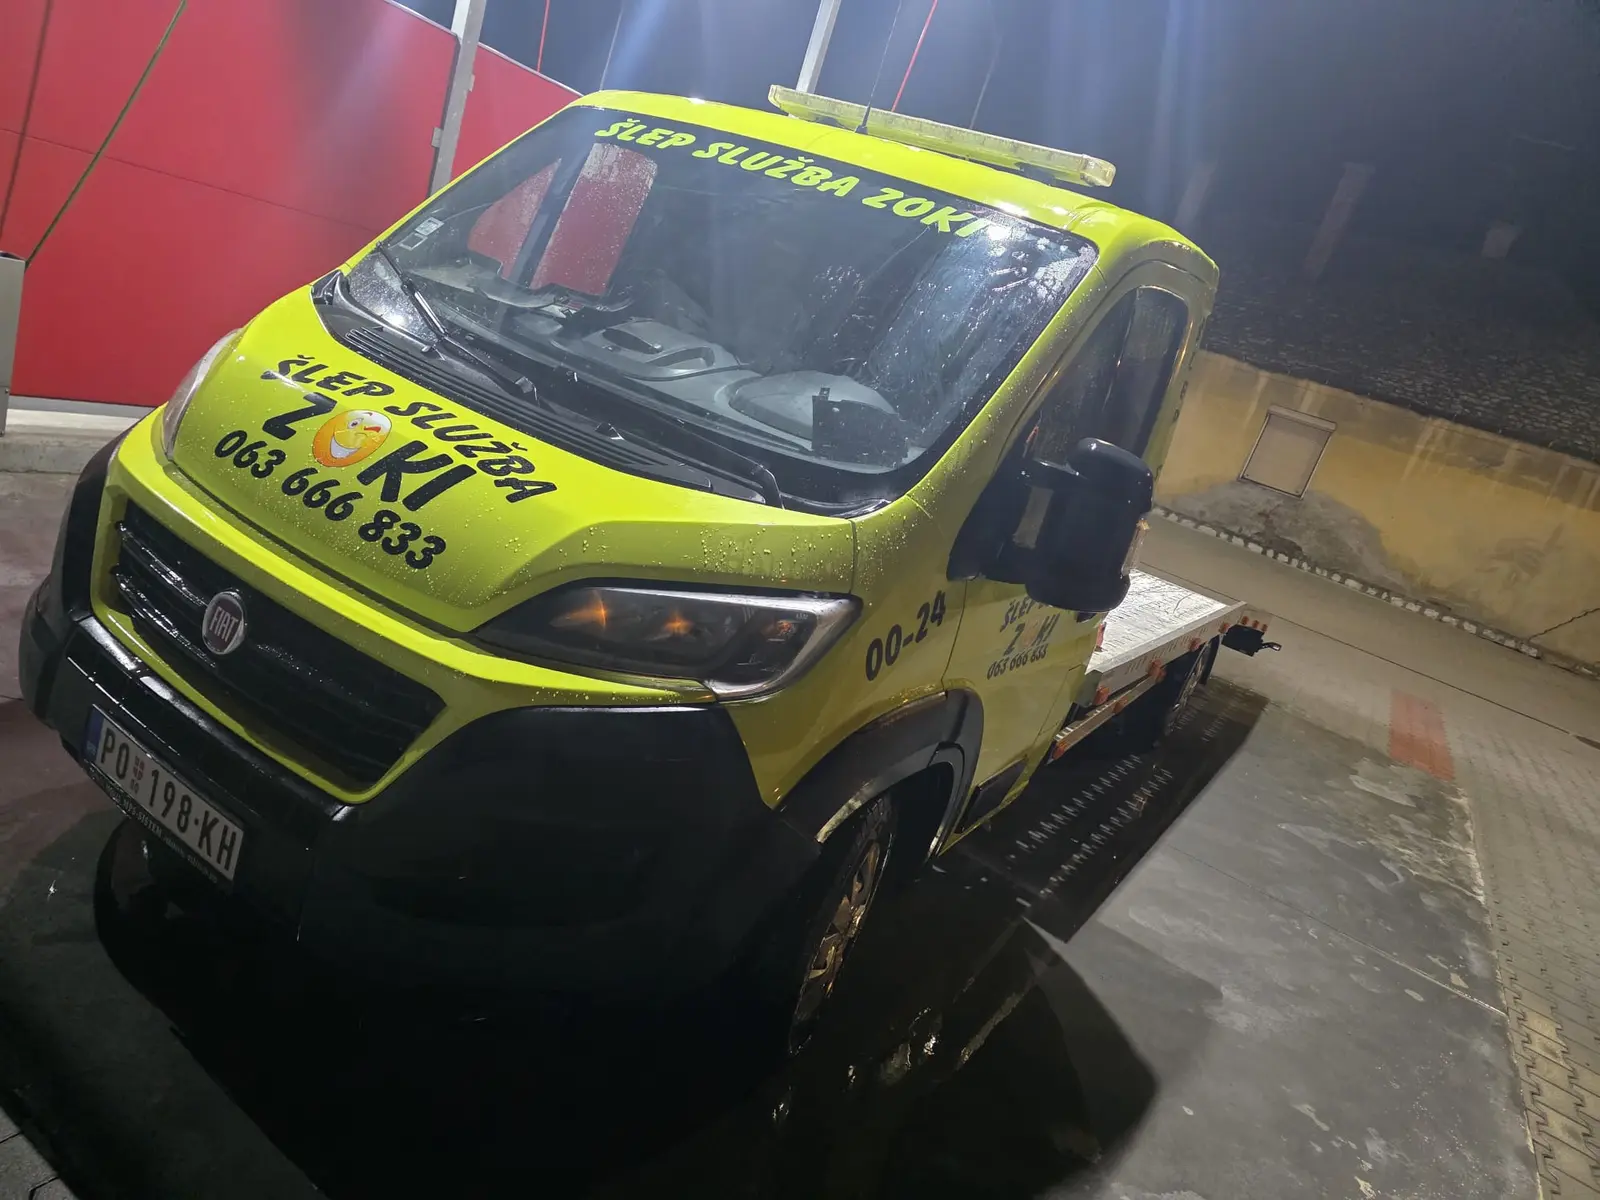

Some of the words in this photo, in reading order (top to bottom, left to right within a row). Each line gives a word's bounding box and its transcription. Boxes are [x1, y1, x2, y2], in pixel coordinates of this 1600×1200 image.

[594, 118, 696, 150] ŠLEP
[692, 141, 860, 197] SLUŽBA
[862, 187, 990, 238] ZOKI
[260, 354, 395, 397] ŠLEP
[383, 401, 558, 503] SLUŽBA
[214, 430, 287, 479] 063
[281, 467, 365, 522] 666
[358, 509, 447, 570] 833
[209, 606, 240, 642] FIAT
[865, 590, 946, 682] 00-24
[101, 727, 131, 781] PO
